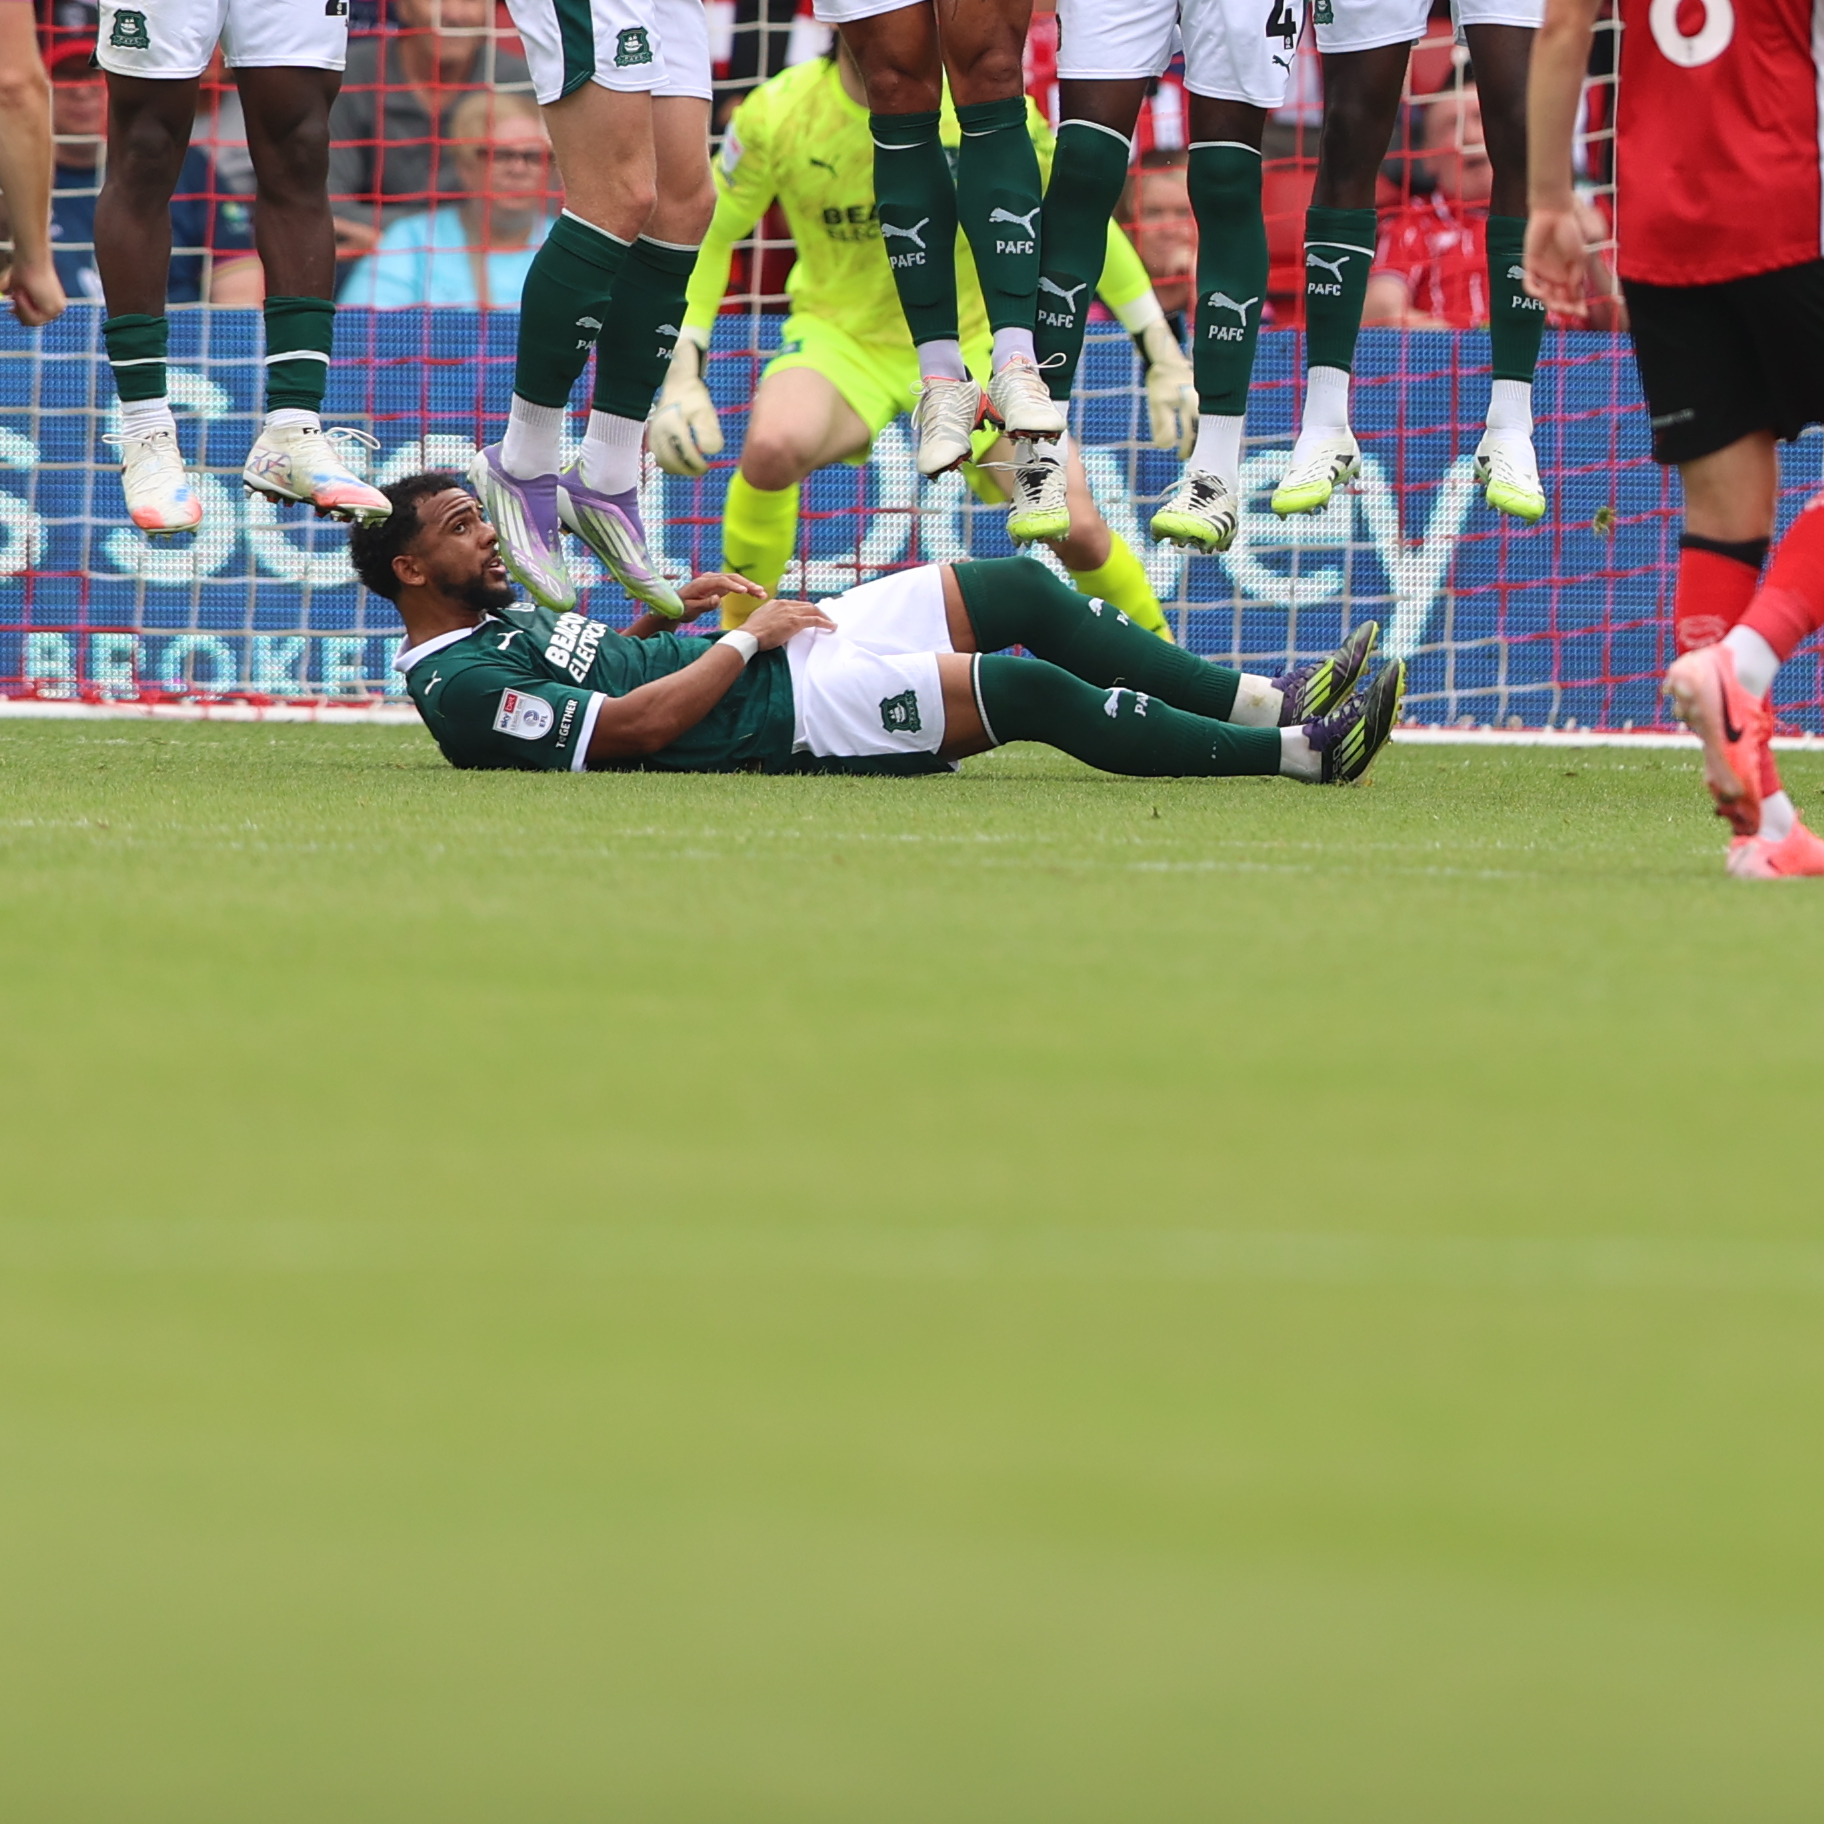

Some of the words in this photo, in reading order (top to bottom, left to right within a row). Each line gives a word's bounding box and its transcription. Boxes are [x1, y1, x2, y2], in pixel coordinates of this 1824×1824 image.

[996, 240, 1035, 255] PAFC
[890, 251, 926, 270] PAFC
[1307, 282, 1342, 296] PAFC
[1038, 309, 1074, 328] PAFC
[1208, 325, 1244, 342] PAFC
[24, 631, 416, 700] BROKE
